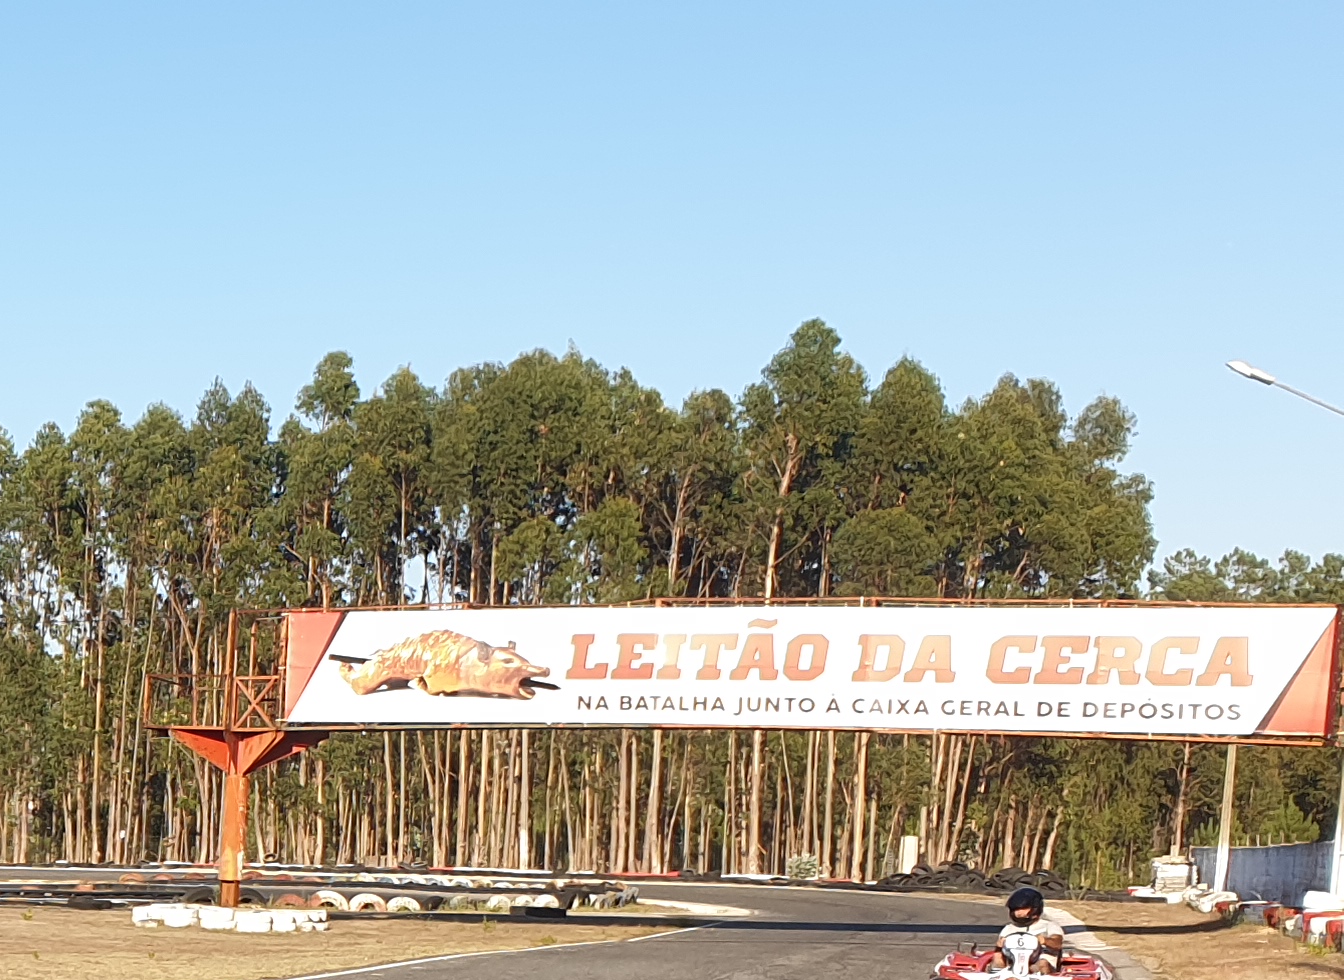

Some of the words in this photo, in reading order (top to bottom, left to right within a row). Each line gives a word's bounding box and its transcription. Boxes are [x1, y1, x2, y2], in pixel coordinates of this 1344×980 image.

[566, 618, 830, 681] LEITÃO
[852, 634, 956, 683] DA
[985, 635, 1254, 686] CERCA
[577, 695, 609, 711] NA
[620, 696, 725, 712] BATALHA
[734, 697, 815, 716] JUNTO
[852, 698, 930, 715] CAIXA
[941, 699, 1025, 718] GERAL
[1037, 701, 1071, 718] DE
[1082, 698, 1241, 720] DEPÓSITOS
